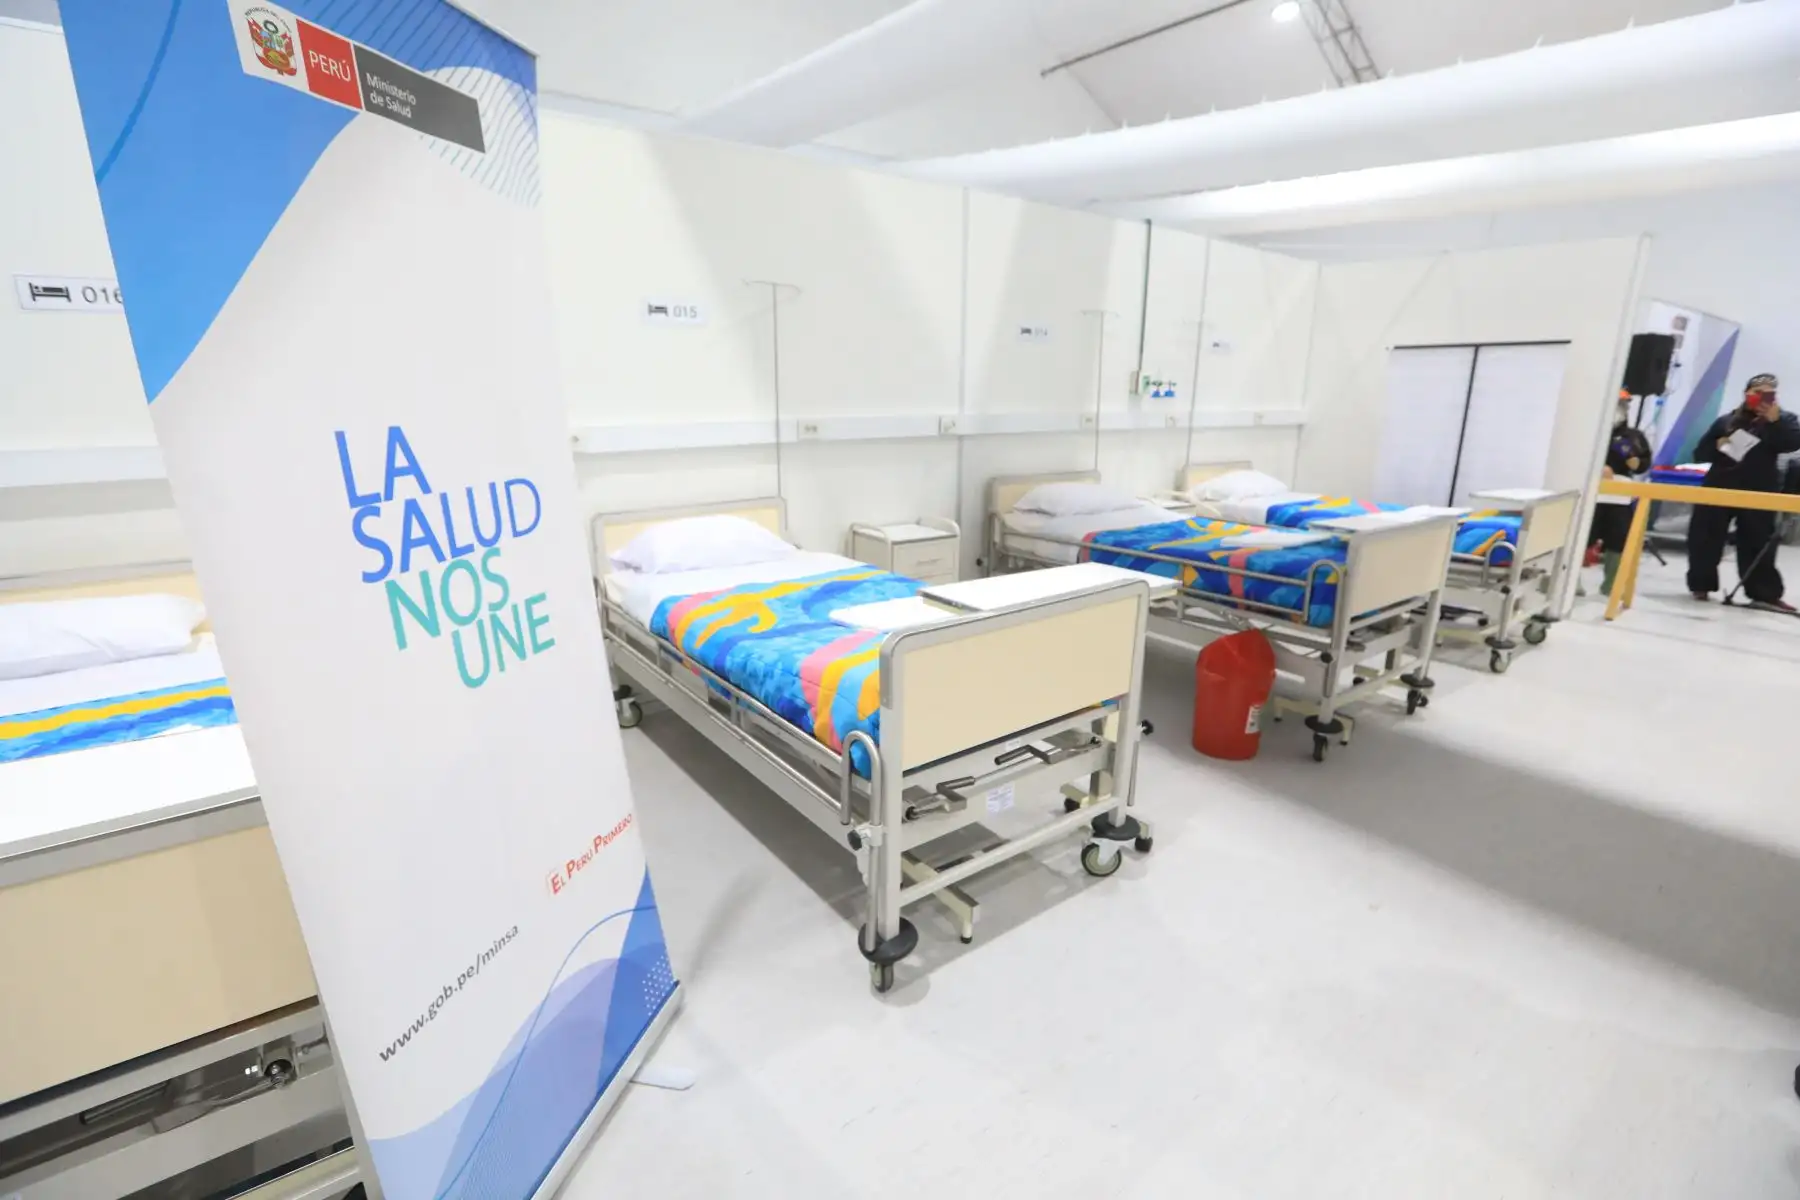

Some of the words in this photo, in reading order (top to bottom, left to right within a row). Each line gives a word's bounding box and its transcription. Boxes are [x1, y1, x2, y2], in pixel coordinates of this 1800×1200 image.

[308, 49, 352, 82] PERÚ
[366, 72, 416, 105] Ministerio
[370, 91, 384, 107] de
[385, 95, 412, 118] Salud
[673, 305, 698, 318] 015
[334, 425, 433, 510] LA
[351, 477, 542, 584] SALUD
[384, 546, 510, 651] NOS
[451, 591, 556, 689] UNE
[378, 924, 520, 1062] www.gob.pe/minsa
